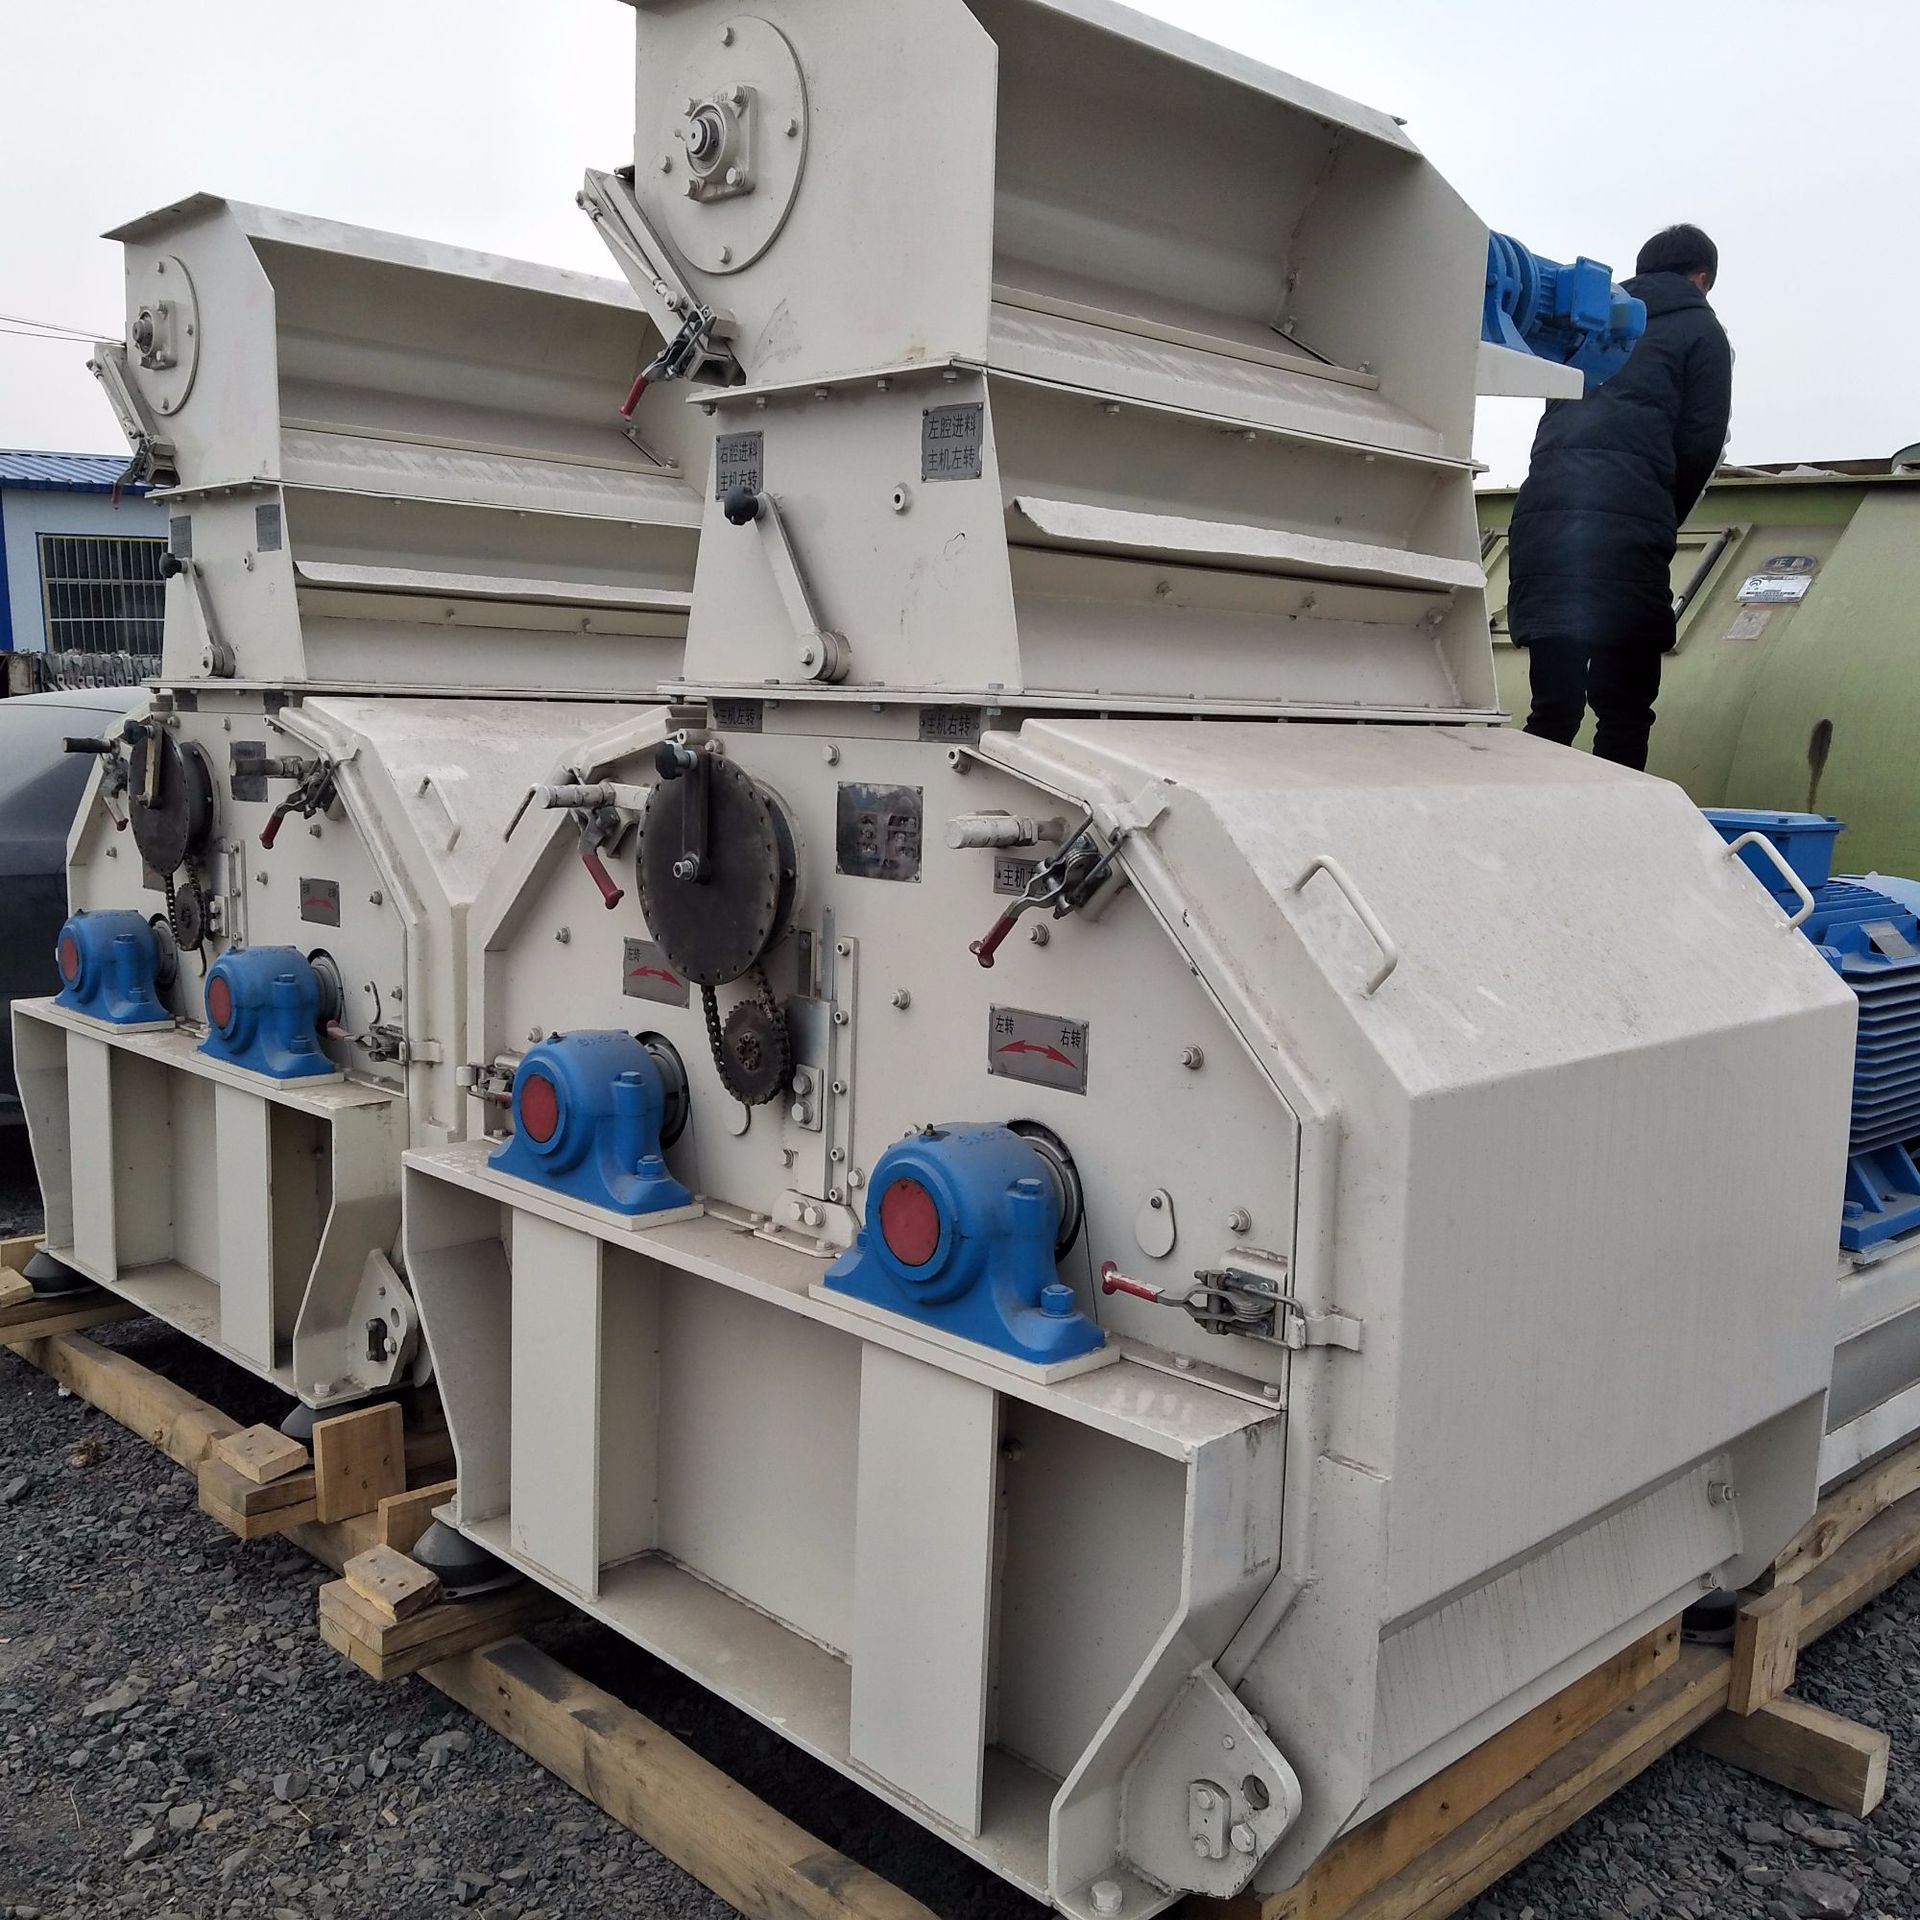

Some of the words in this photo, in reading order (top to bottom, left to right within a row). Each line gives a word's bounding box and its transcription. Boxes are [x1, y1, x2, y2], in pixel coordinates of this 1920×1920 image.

[928, 412, 976, 440] 左腔进料
[928, 445, 975, 471] 主机左转
[995, 1015, 1014, 1036] 左转
[1060, 1027, 1081, 1049] 右转
